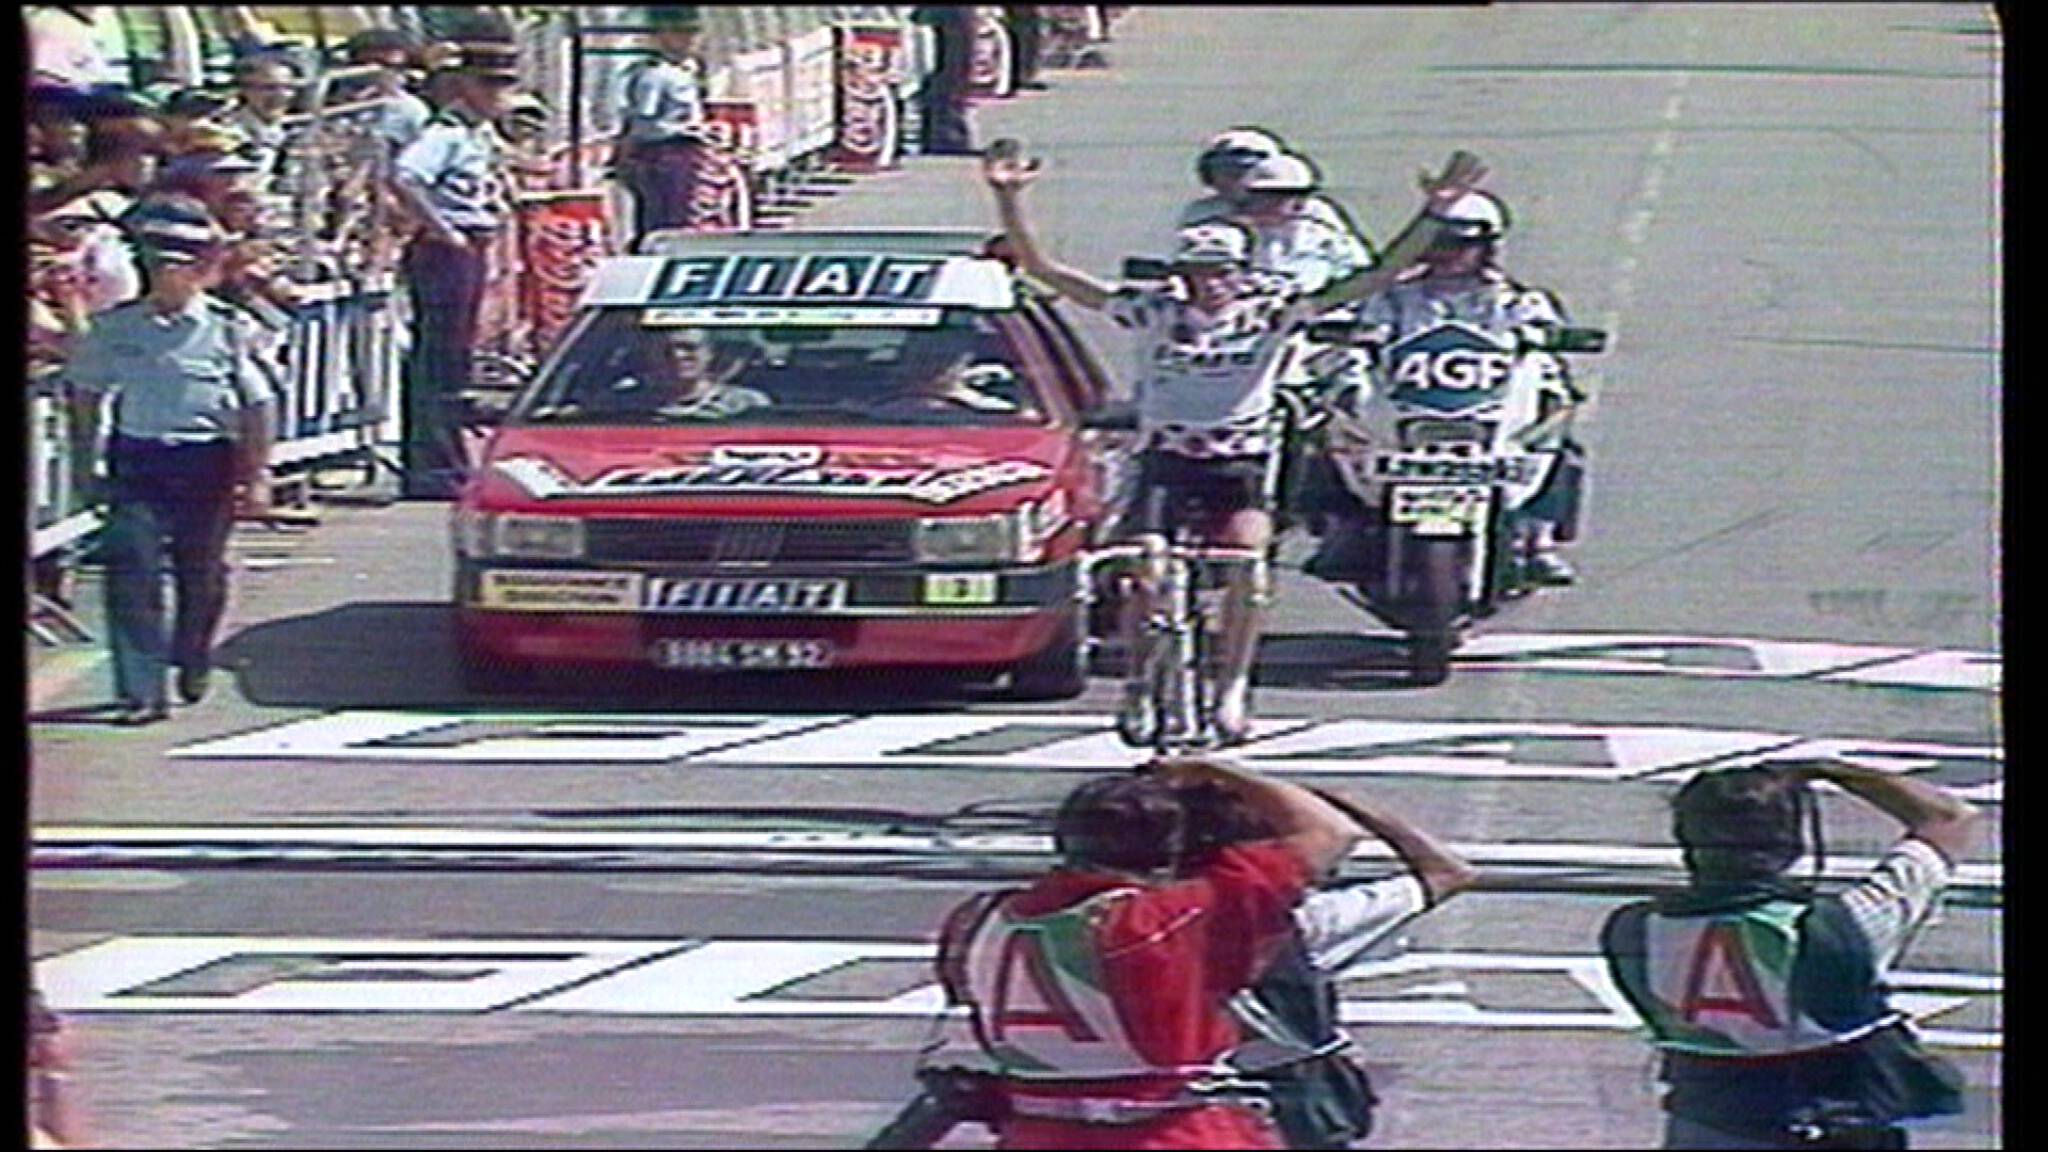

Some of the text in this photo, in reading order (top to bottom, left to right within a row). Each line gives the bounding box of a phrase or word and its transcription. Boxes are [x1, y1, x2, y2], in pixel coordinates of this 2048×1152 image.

[669, 262, 931, 294] FIAT
[1395, 350, 1514, 389] AGF
[667, 582, 828, 607] FIAT
[992, 929, 1104, 1041] A
[1683, 921, 1783, 1028] A
